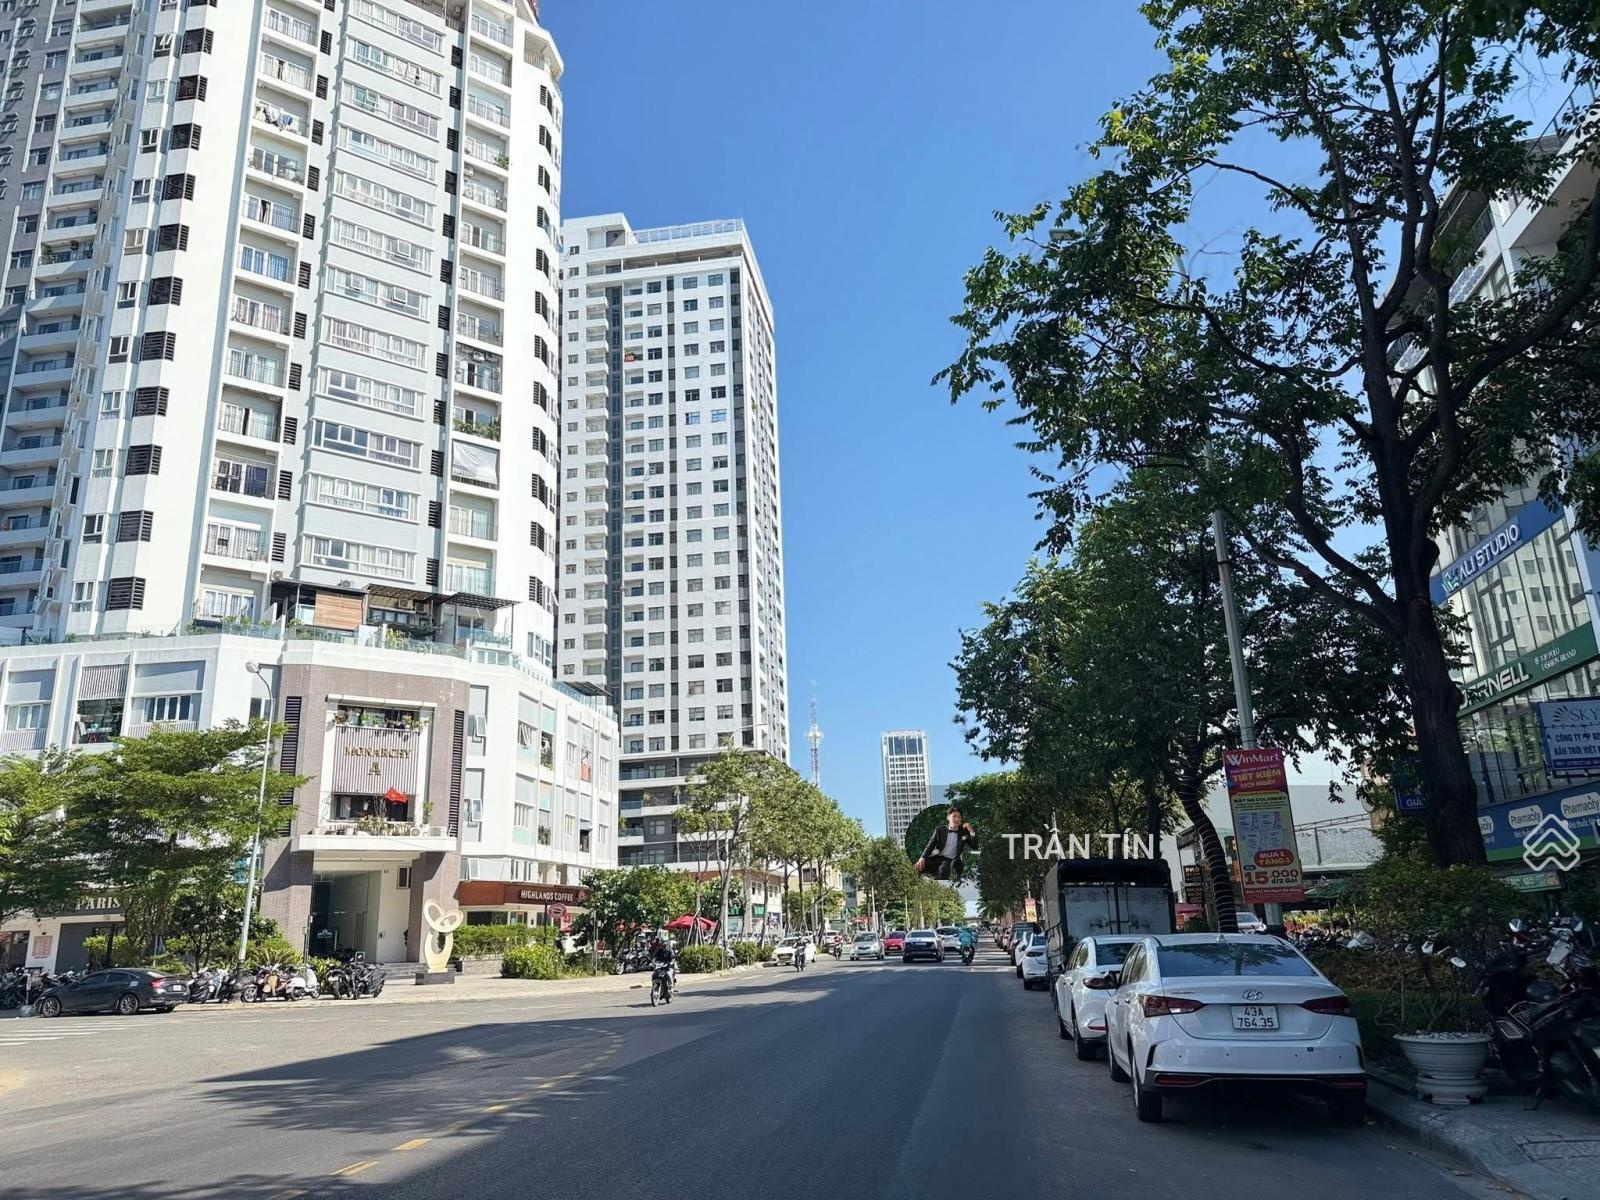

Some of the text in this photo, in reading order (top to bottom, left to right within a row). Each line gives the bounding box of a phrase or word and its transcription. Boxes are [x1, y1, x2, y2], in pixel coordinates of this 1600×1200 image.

[1475, 524, 1519, 568] STUDIO
[344, 745, 411, 759] MONARCHY
[1226, 752, 1281, 766] WinMart
[1563, 797, 1600, 815] Pharmacity
[1510, 809, 1541, 825] Pharmacity
[1244, 869, 1299, 885] 15.000
[520, 889, 574, 902] HIGHLANDS COFFEE
[75, 896, 121, 910] PARIS
[1244, 1006, 1265, 1017] 43A
[1237, 1017, 1275, 1028] 764.35
